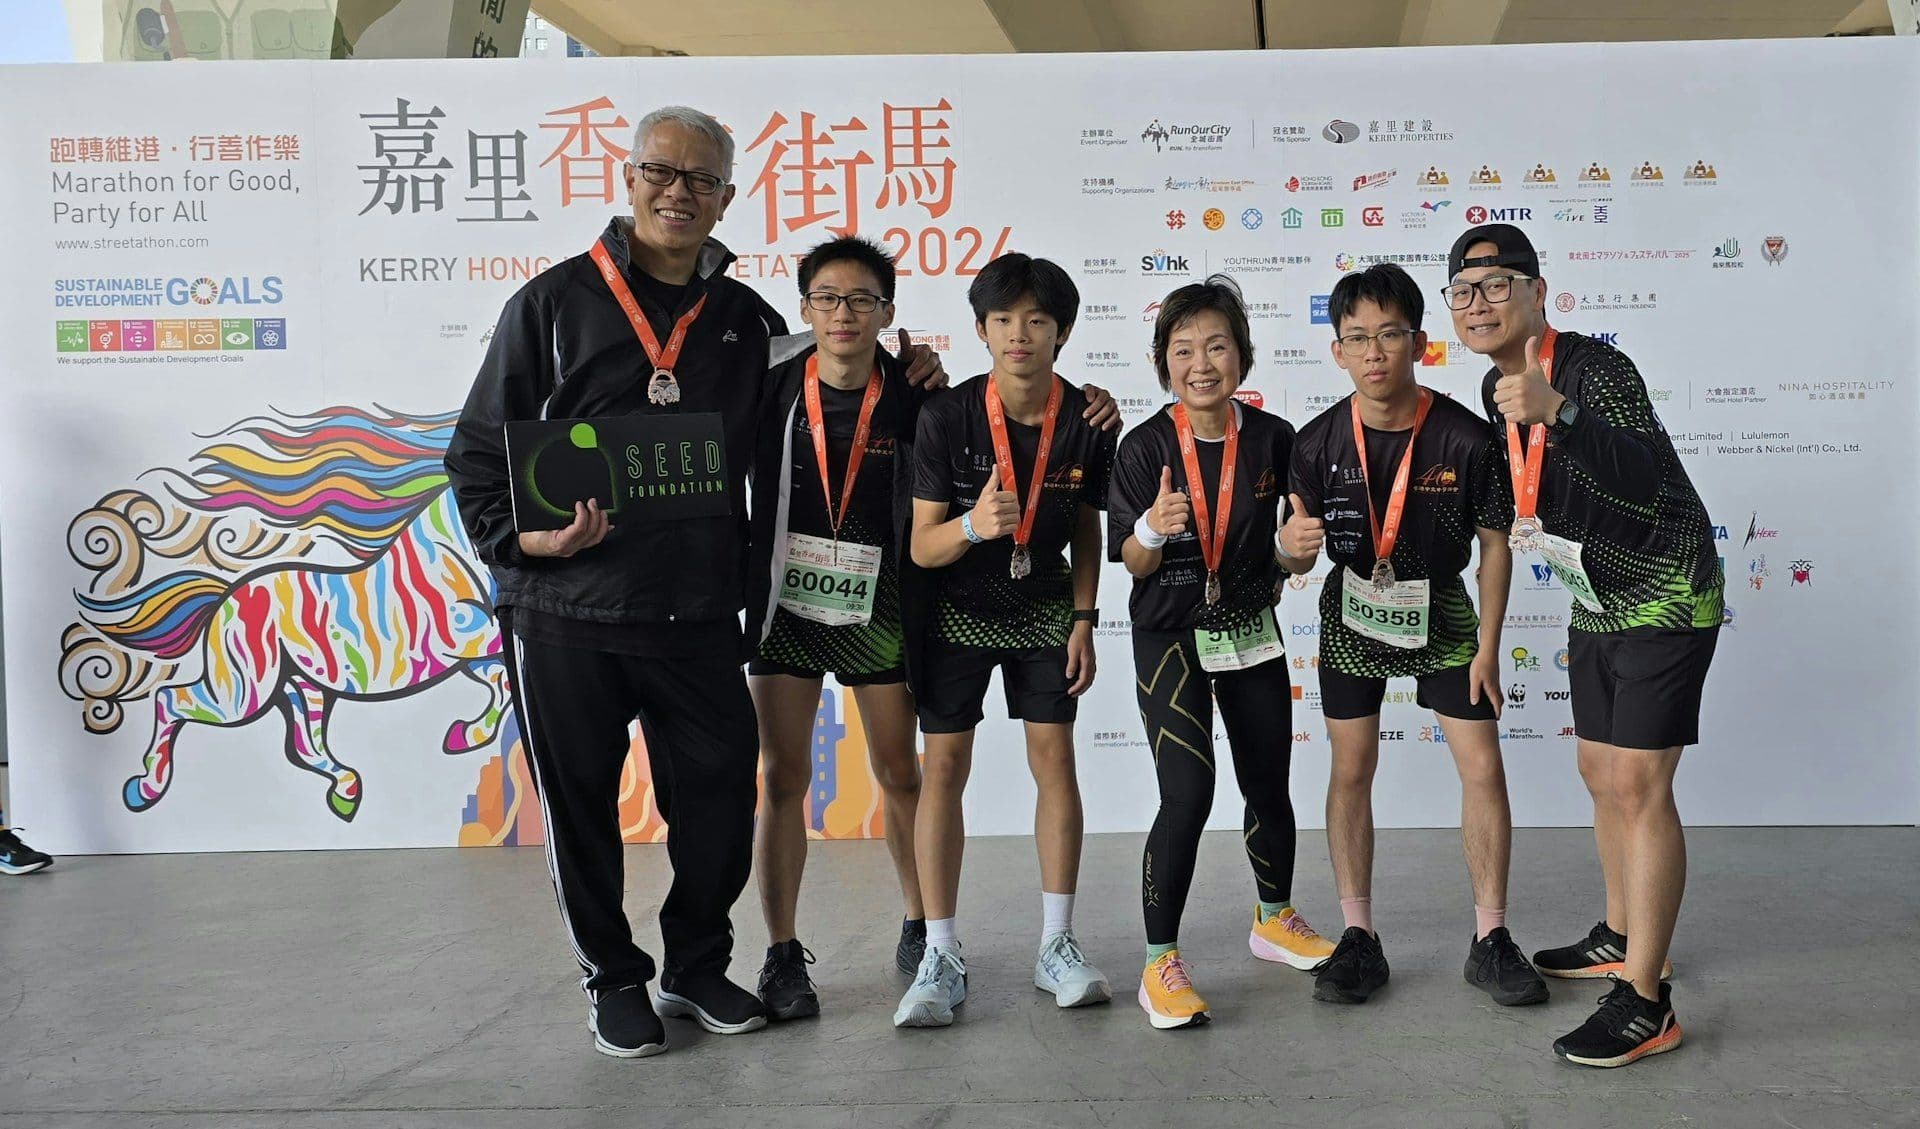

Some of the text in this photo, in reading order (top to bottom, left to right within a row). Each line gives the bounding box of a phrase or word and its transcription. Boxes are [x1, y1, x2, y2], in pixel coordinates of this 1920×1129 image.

[1170, 124, 1231, 136] RunOurCity
[1368, 119, 1433, 132] 嘉里建設
[1286, 136, 1311, 144] Sponsor
[1368, 132, 1453, 142] KERRY PROPERTIES
[52, 168, 301, 195] Marathon for Good,
[1082, 187, 1114, 196] Supporting
[53, 199, 208, 229] Party for All
[1490, 208, 1532, 221] MTR
[55, 235, 209, 250] www.streetathon.com
[359, 257, 457, 282] KERRY
[1141, 256, 1190, 271] SVhk
[1084, 268, 1103, 276] Impact
[55, 278, 163, 292] SUSTAINABLE
[166, 276, 283, 306] GOALS
[55, 293, 163, 307] DEVELOPMENT
[1085, 314, 1104, 322] Sports
[57, 354, 244, 365] We support the Sustainable Development Goals
[1106, 361, 1130, 369] Sponsor
[1779, 381, 1895, 392] NINA HOSPITALITY
[1688, 432, 1723, 441] Limited
[1741, 431, 1790, 440] Lululemon
[1717, 445, 1754, 454] Webber
[1756, 445, 1763, 454] &
[1765, 444, 1794, 453] Nickel
[1822, 444, 1841, 454] Co.,
[1844, 443, 1862, 453] Ltd.
[625, 441, 721, 479] SEED
[629, 480, 724, 499] FOUNDATION
[785, 568, 868, 599] 60044
[1348, 596, 1421, 627] 50358
[1094, 741, 1129, 749] International
